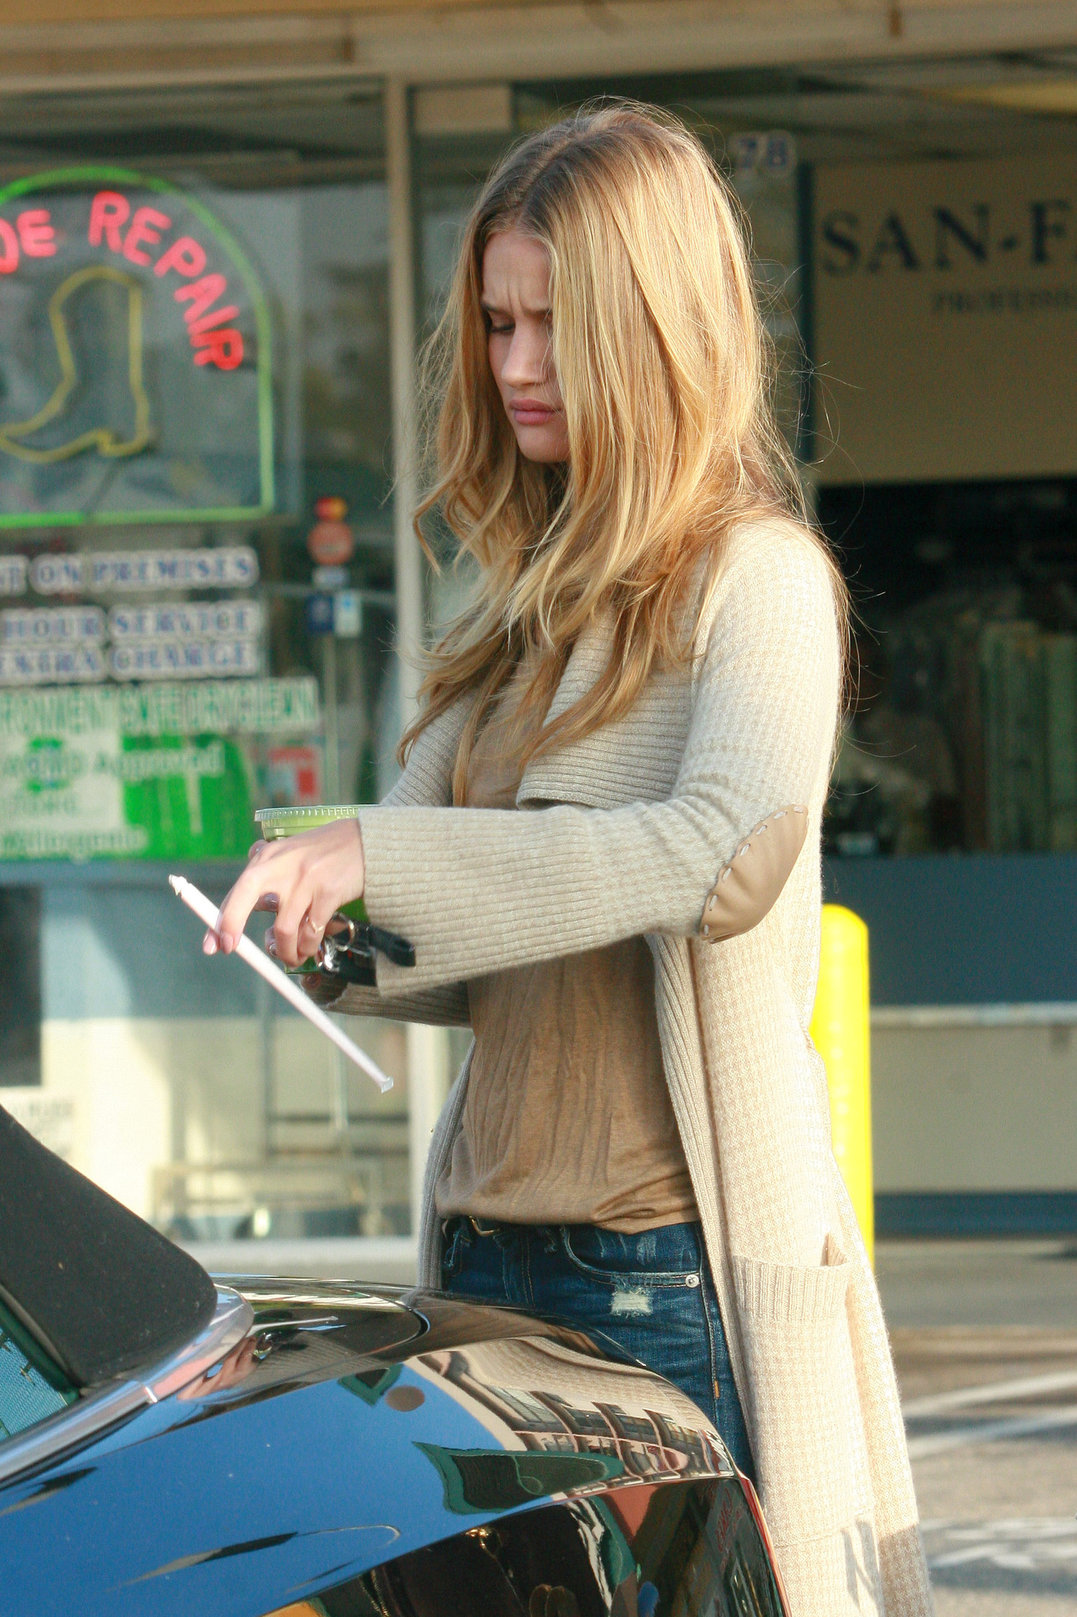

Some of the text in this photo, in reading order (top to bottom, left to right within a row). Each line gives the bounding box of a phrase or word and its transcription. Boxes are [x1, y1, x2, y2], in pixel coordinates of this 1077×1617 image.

[821, 200, 1077, 277] SAN-F
[88, 190, 244, 371] REPAIR
[38, 560, 82, 585] ON
[92, 555, 252, 584] PREMISES
[3, 609, 250, 638] HOUR SERVICE
[112, 642, 250, 671] CHANGE
